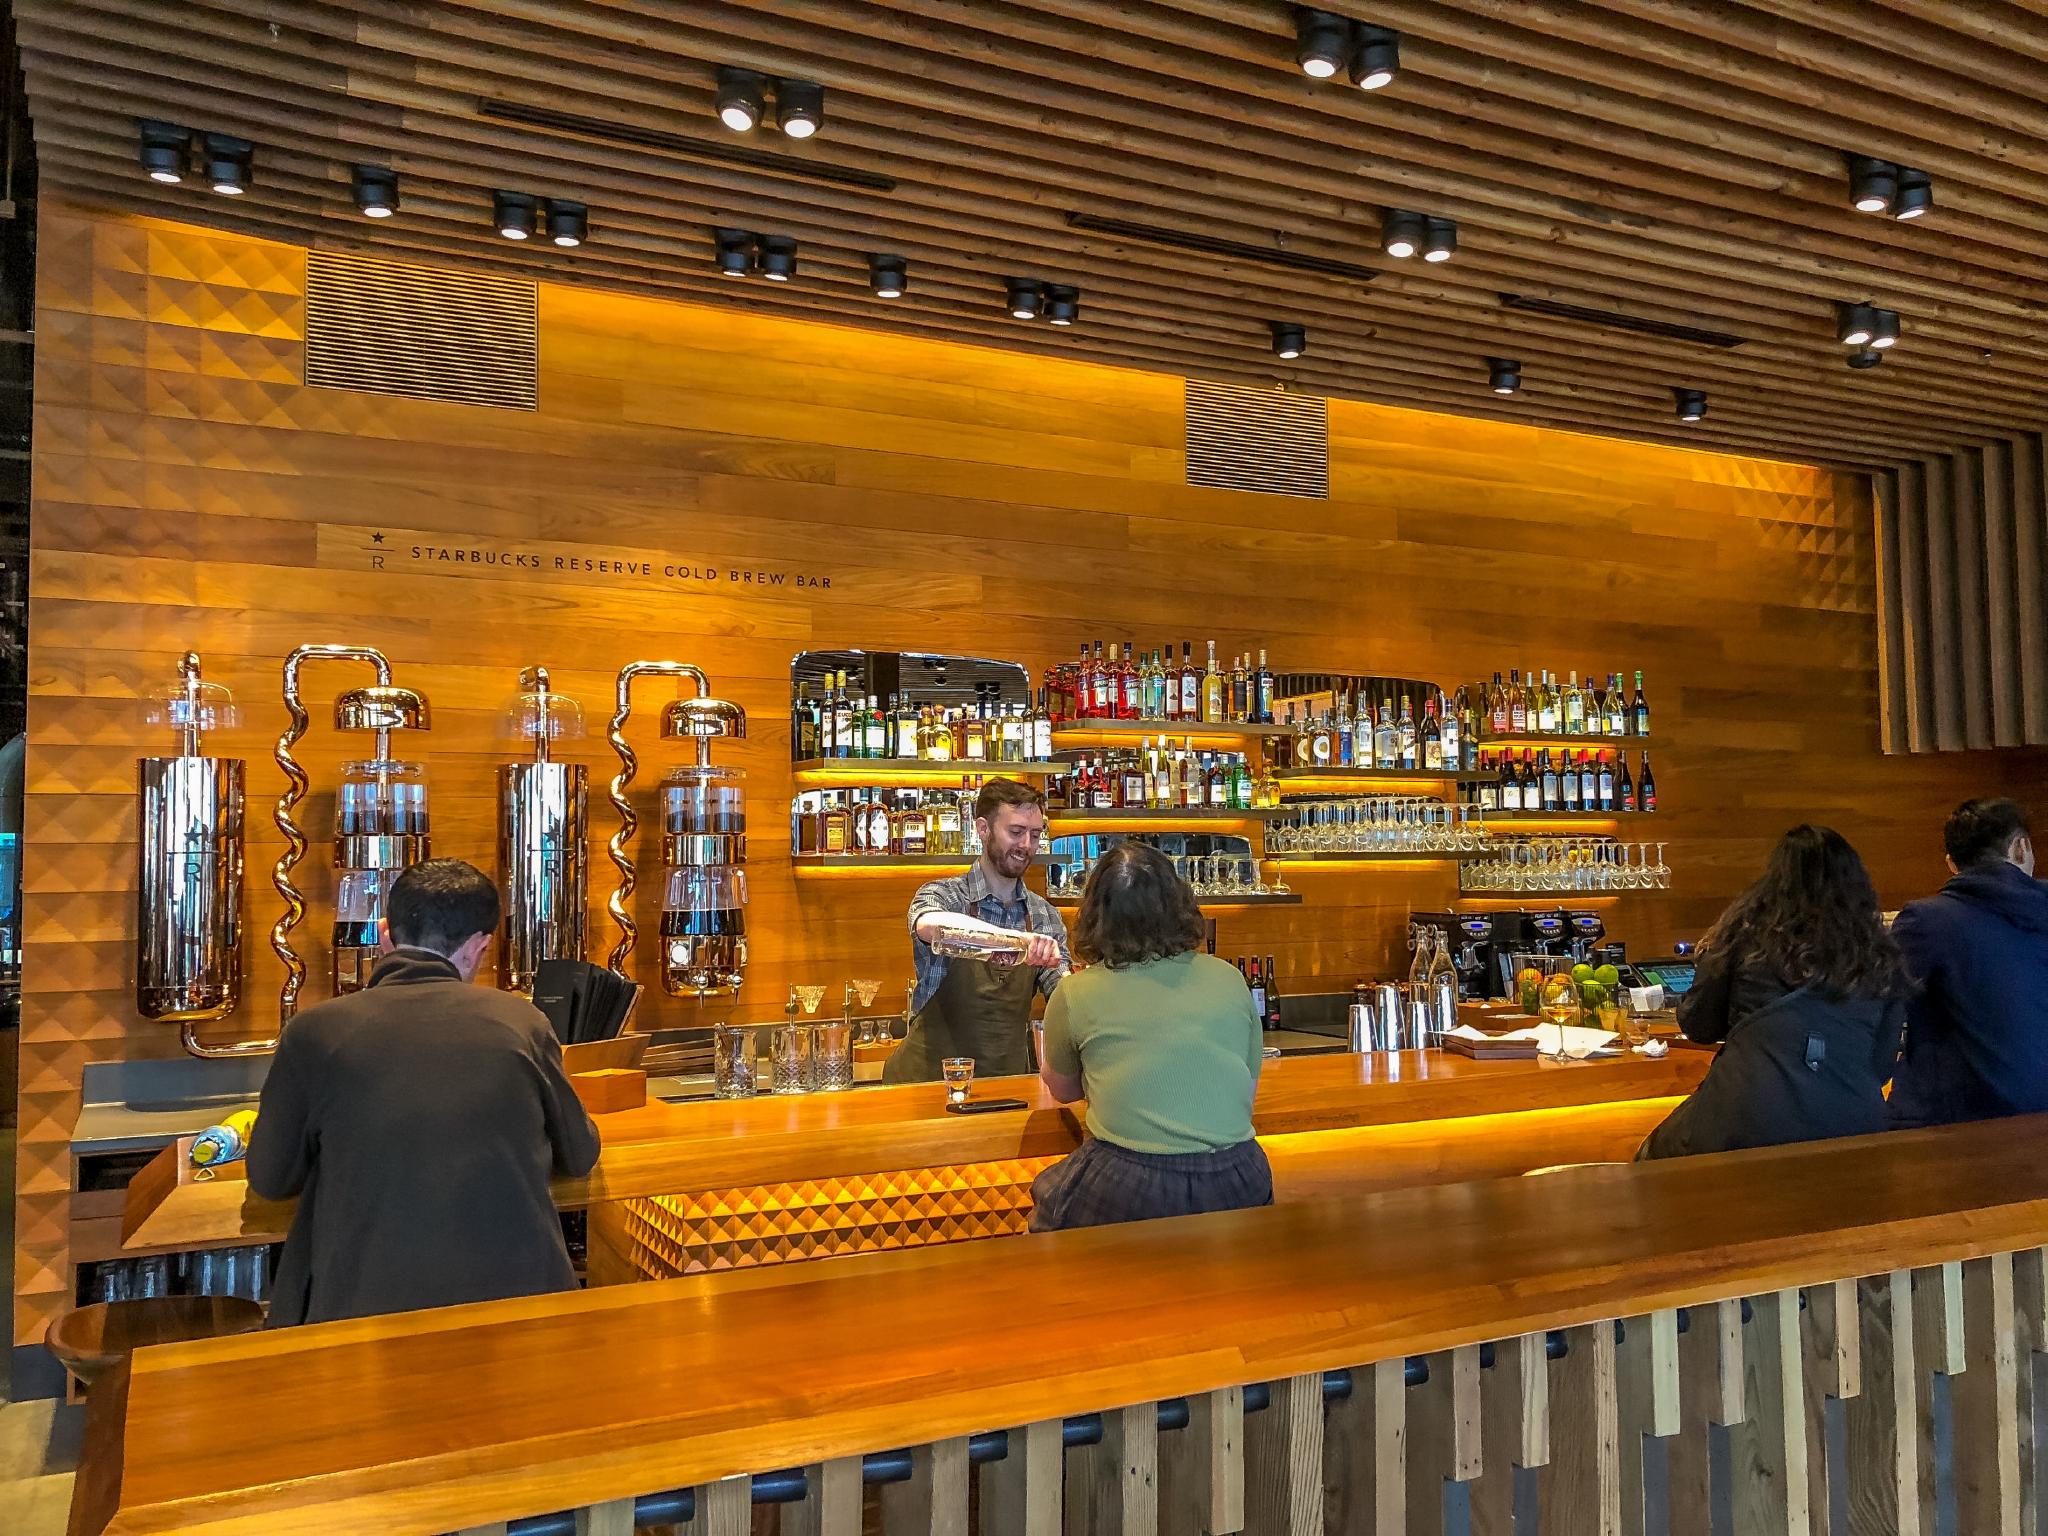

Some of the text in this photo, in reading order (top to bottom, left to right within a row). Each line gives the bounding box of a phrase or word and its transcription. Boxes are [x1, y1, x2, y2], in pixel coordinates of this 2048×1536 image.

[371, 556, 385, 570] R
[411, 546, 832, 589] STARBUCKS RESERVE COLD BREW BAR
[183, 862, 201, 882] R
